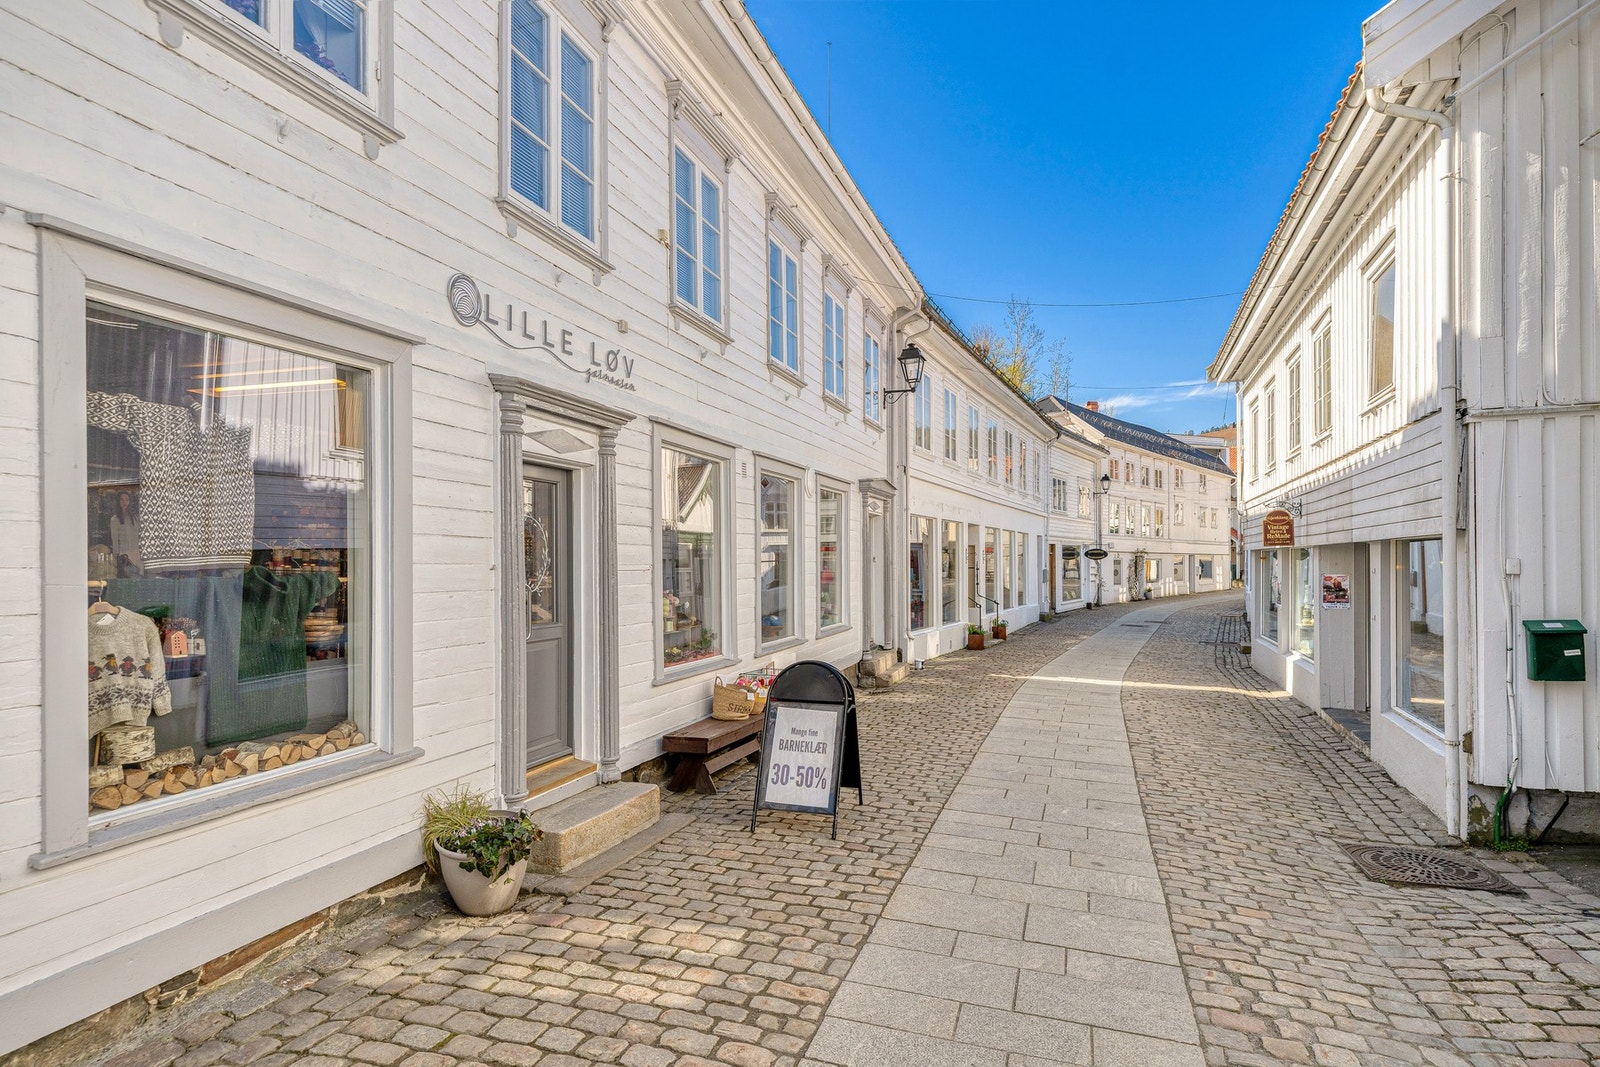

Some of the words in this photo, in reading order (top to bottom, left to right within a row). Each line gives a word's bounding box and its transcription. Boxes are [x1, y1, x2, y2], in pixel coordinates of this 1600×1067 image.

[484, 294, 573, 355] LILLE
[590, 342, 635, 378] LØV
[791, 727, 807, 737] Mange
[808, 729, 818, 737] fine
[779, 739, 828, 754] BARNEKLÆR
[771, 763, 827, 790] 30-50%
